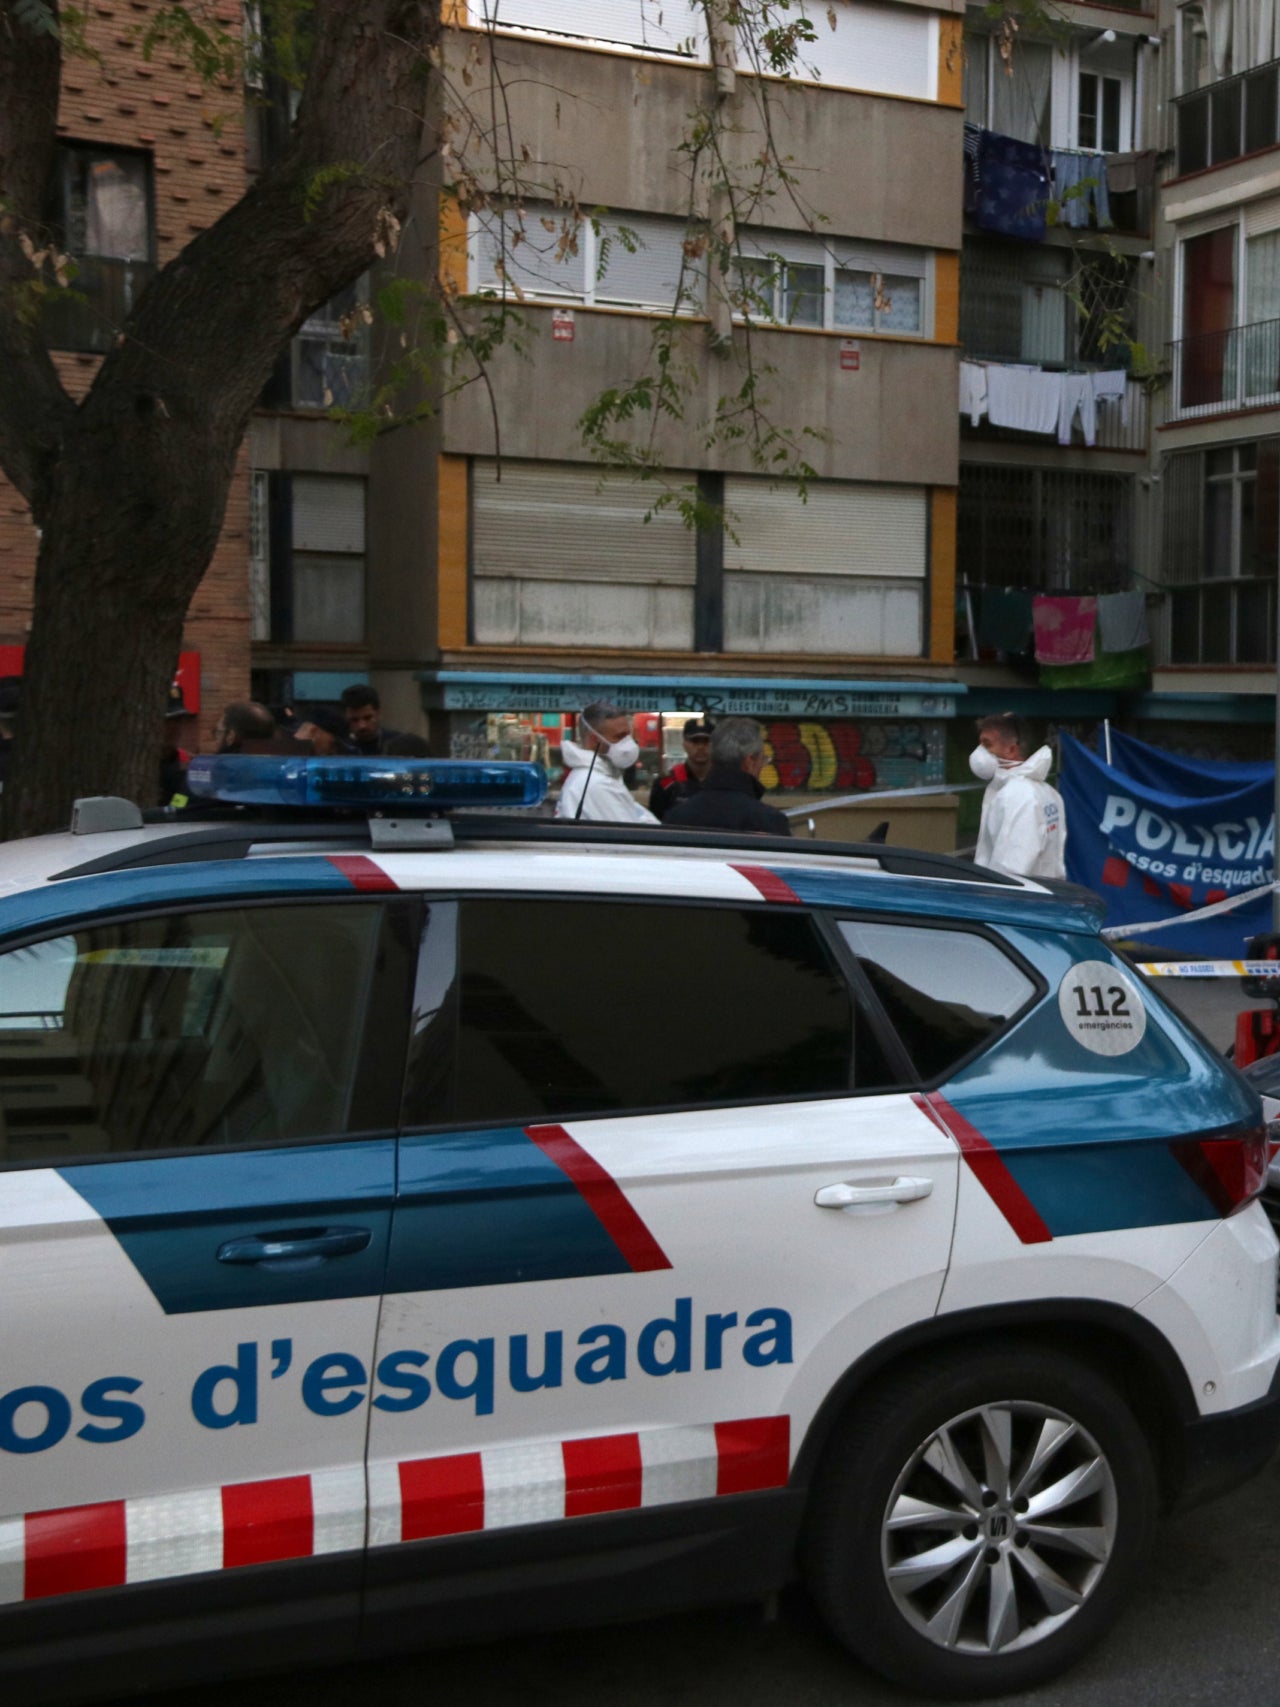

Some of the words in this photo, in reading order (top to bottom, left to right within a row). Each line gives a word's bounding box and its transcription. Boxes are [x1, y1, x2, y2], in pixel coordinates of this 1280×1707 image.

[1109, 841, 1177, 878] ssos
[1182, 862, 1275, 889] d'esquadr
[1073, 986, 1131, 1017] 112
[191, 1298, 796, 1431] d'esquadra
